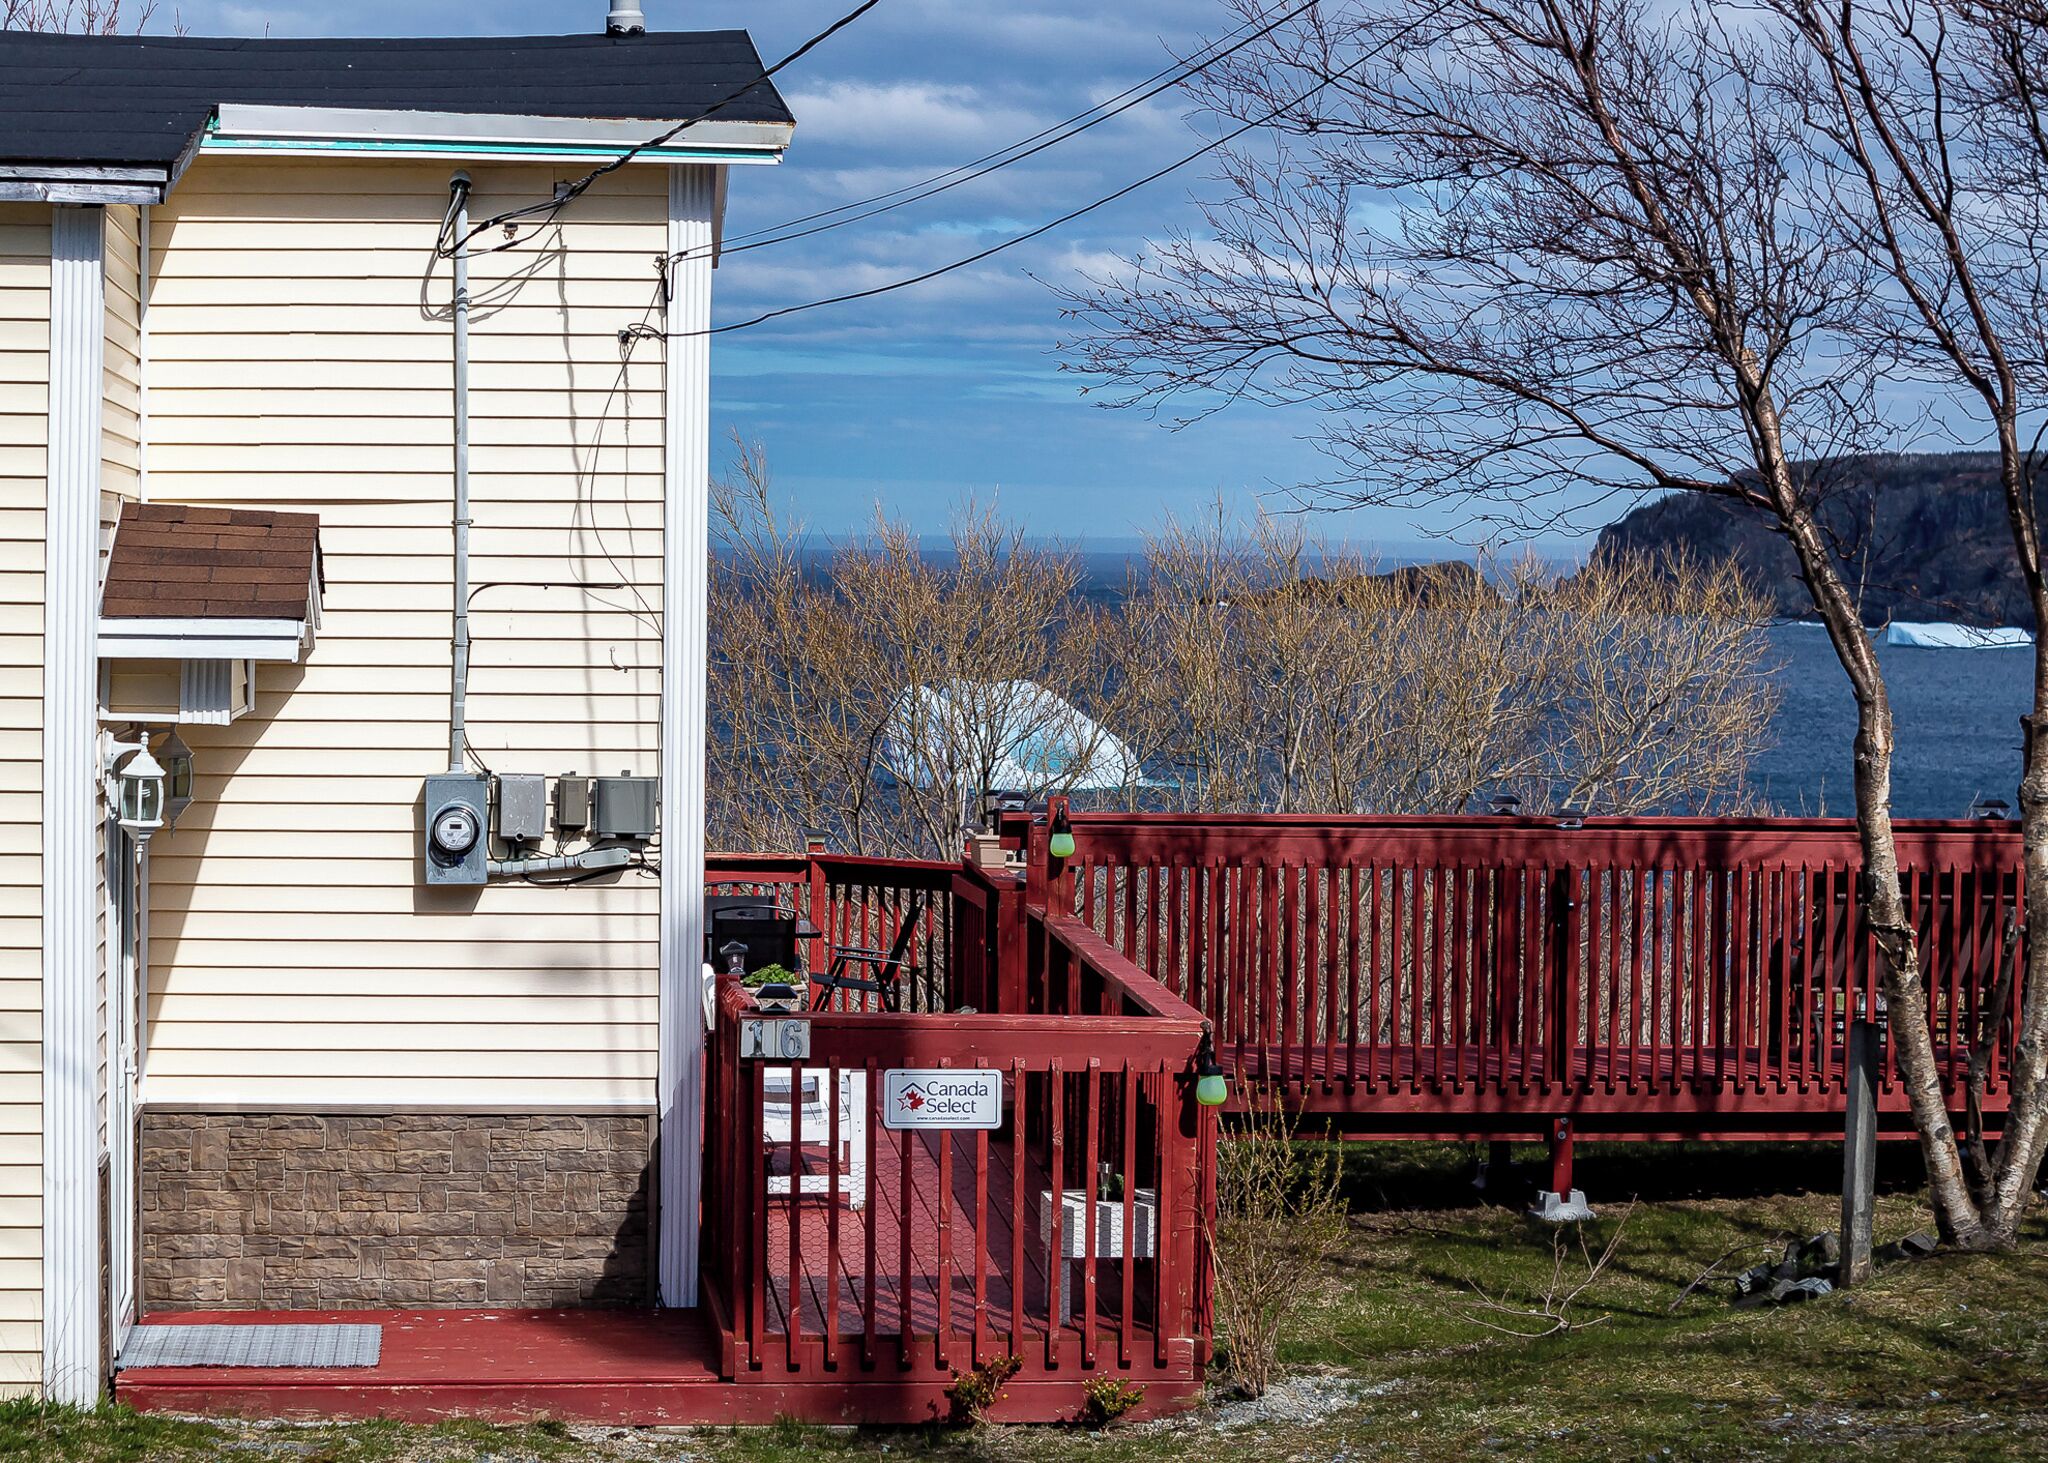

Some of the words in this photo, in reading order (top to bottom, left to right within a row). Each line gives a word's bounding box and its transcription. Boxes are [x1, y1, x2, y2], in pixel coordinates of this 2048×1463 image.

[748, 1020, 803, 1059] 16
[926, 1081, 988, 1097] Canada
[926, 1098, 977, 1114] Select
